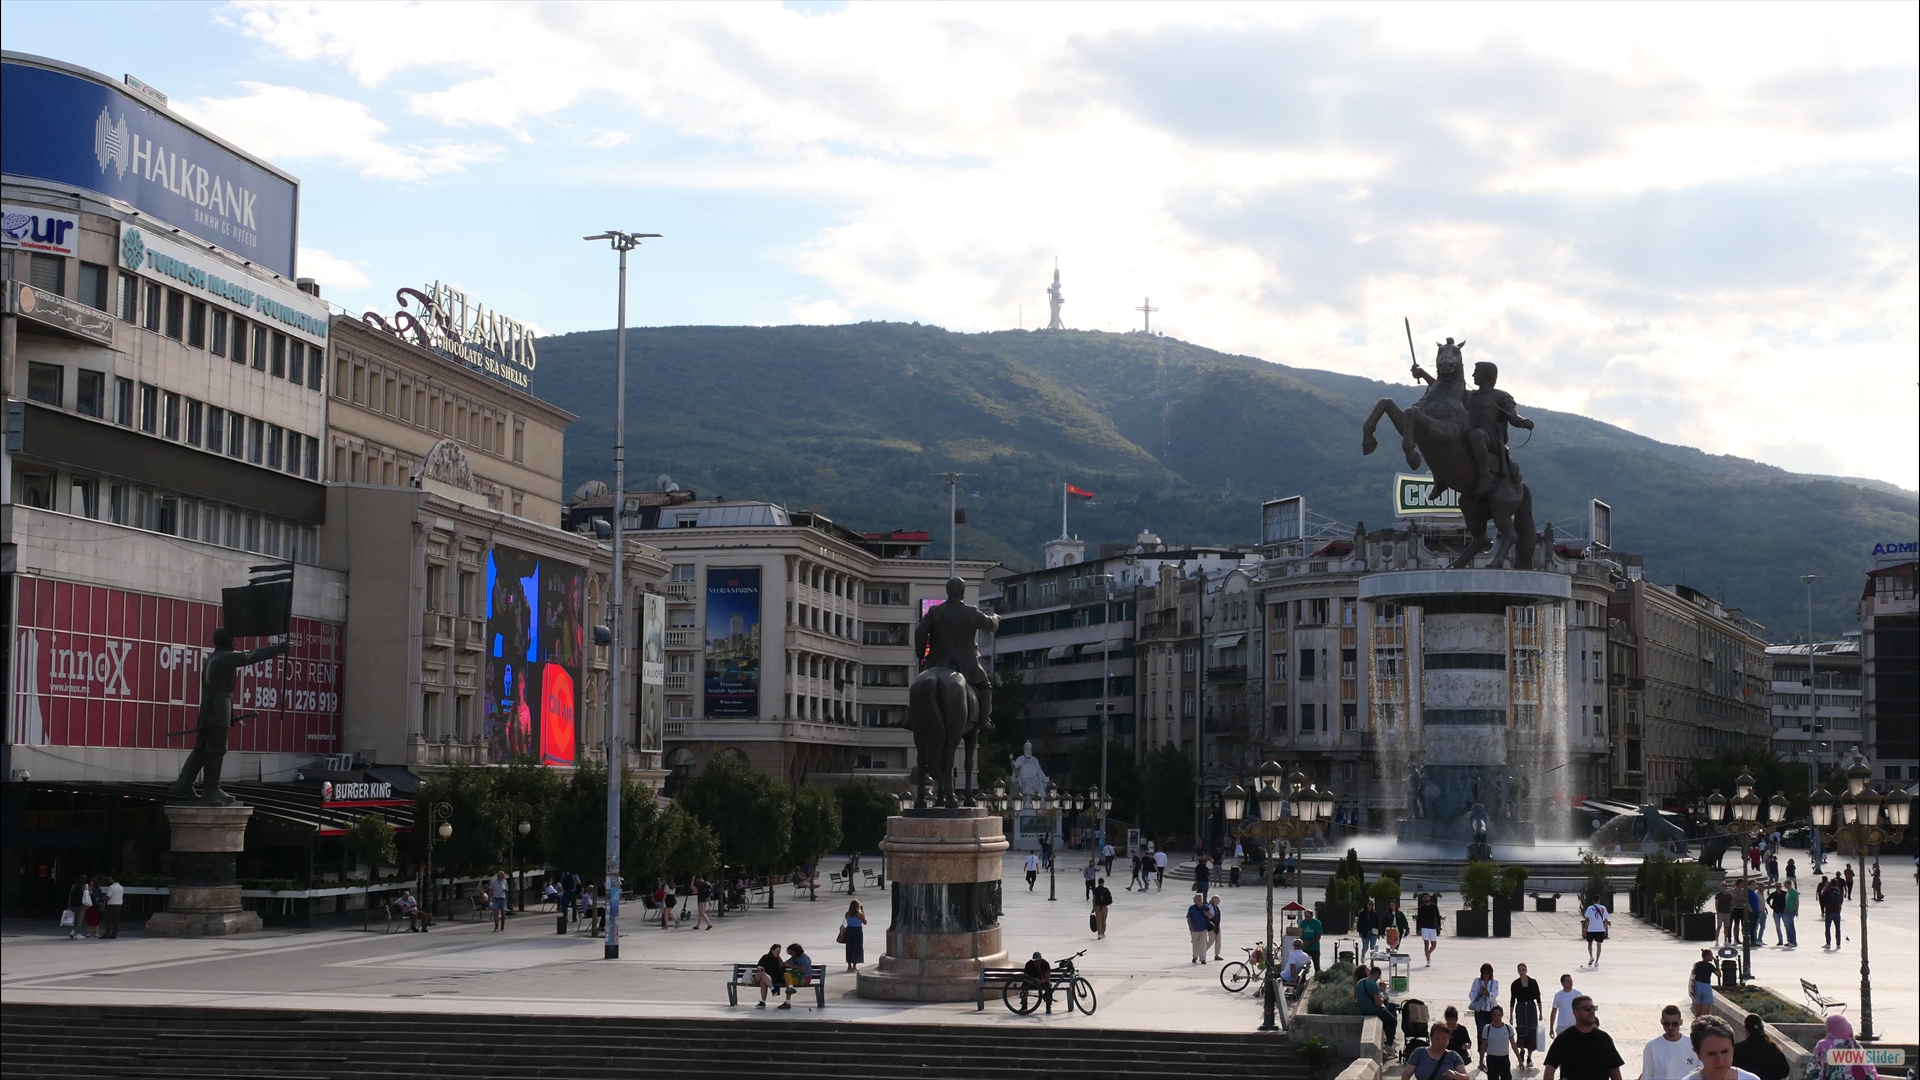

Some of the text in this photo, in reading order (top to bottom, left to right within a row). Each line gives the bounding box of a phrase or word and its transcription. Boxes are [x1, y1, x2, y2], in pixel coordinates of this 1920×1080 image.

[132, 133, 257, 231] HALKBANK
[1, 211, 74, 245] our
[194, 208, 219, 231] ВАЖНИ
[221, 221, 230, 236] СЕ
[20, 241, 72, 254] Welcome Home
[147, 249, 327, 339] TURKISH MAARIF FOUNDATION
[428, 279, 537, 371] ATLANTIS
[436, 334, 529, 388] CHOCOLATE SEA SHELLS
[1871, 542, 1919, 556] ADMI
[306, 635, 339, 647] FORTONMA
[277, 660, 302, 682] FOR
[309, 662, 339, 684] RENT
[244, 688, 251, 703] +
[255, 687, 277, 709] 389
[295, 689, 317, 711] 276
[319, 692, 338, 712] 919
[549, 695, 573, 725] ON AIR
[335, 783, 369, 799] BURGER
[370, 782, 392, 798] KING
